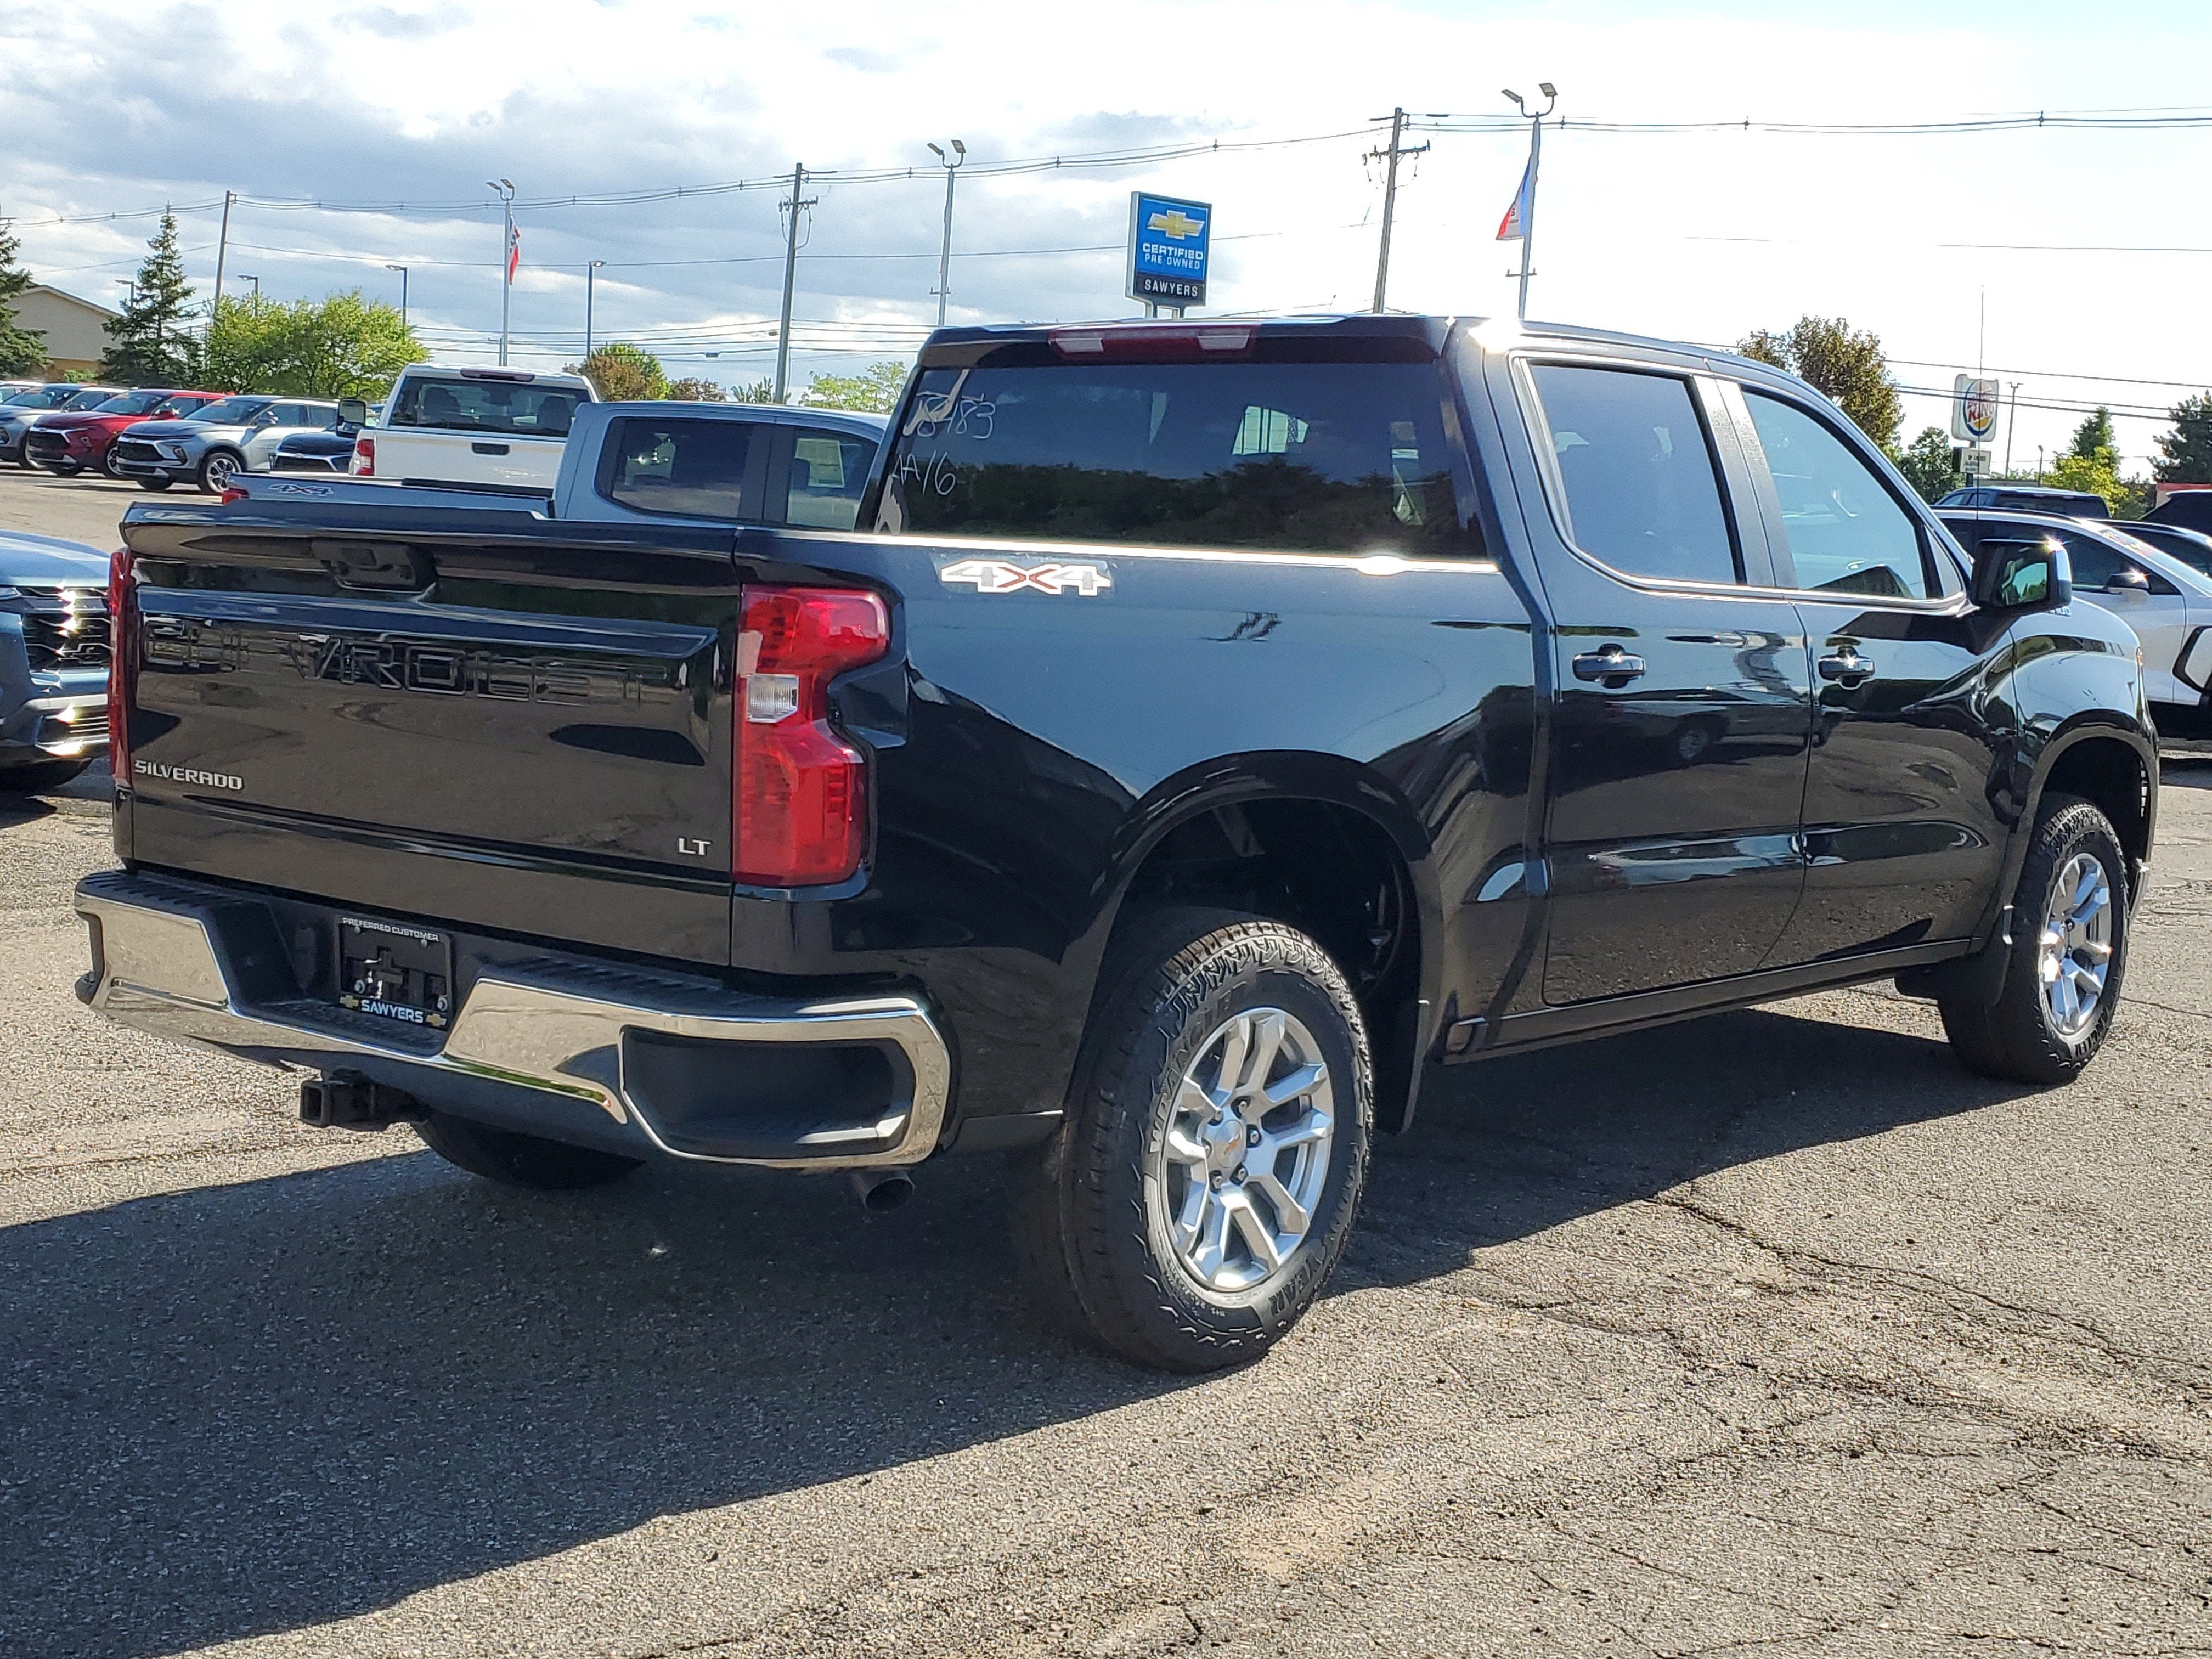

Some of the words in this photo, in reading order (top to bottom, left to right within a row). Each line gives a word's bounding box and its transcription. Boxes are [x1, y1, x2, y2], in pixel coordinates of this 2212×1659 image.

[1142, 242, 1204, 260] CERTIFIED
[1144, 253, 1163, 264] PRE
[1166, 256, 1200, 269] OWNED
[1144, 278, 1198, 297] SAWYERS
[134, 759, 243, 790] SILVERADO
[678, 837, 712, 855] LT
[342, 917, 391, 932] PREFERRED
[391, 926, 439, 942] CUSTOMER
[360, 999, 424, 1024] SAWYERS
